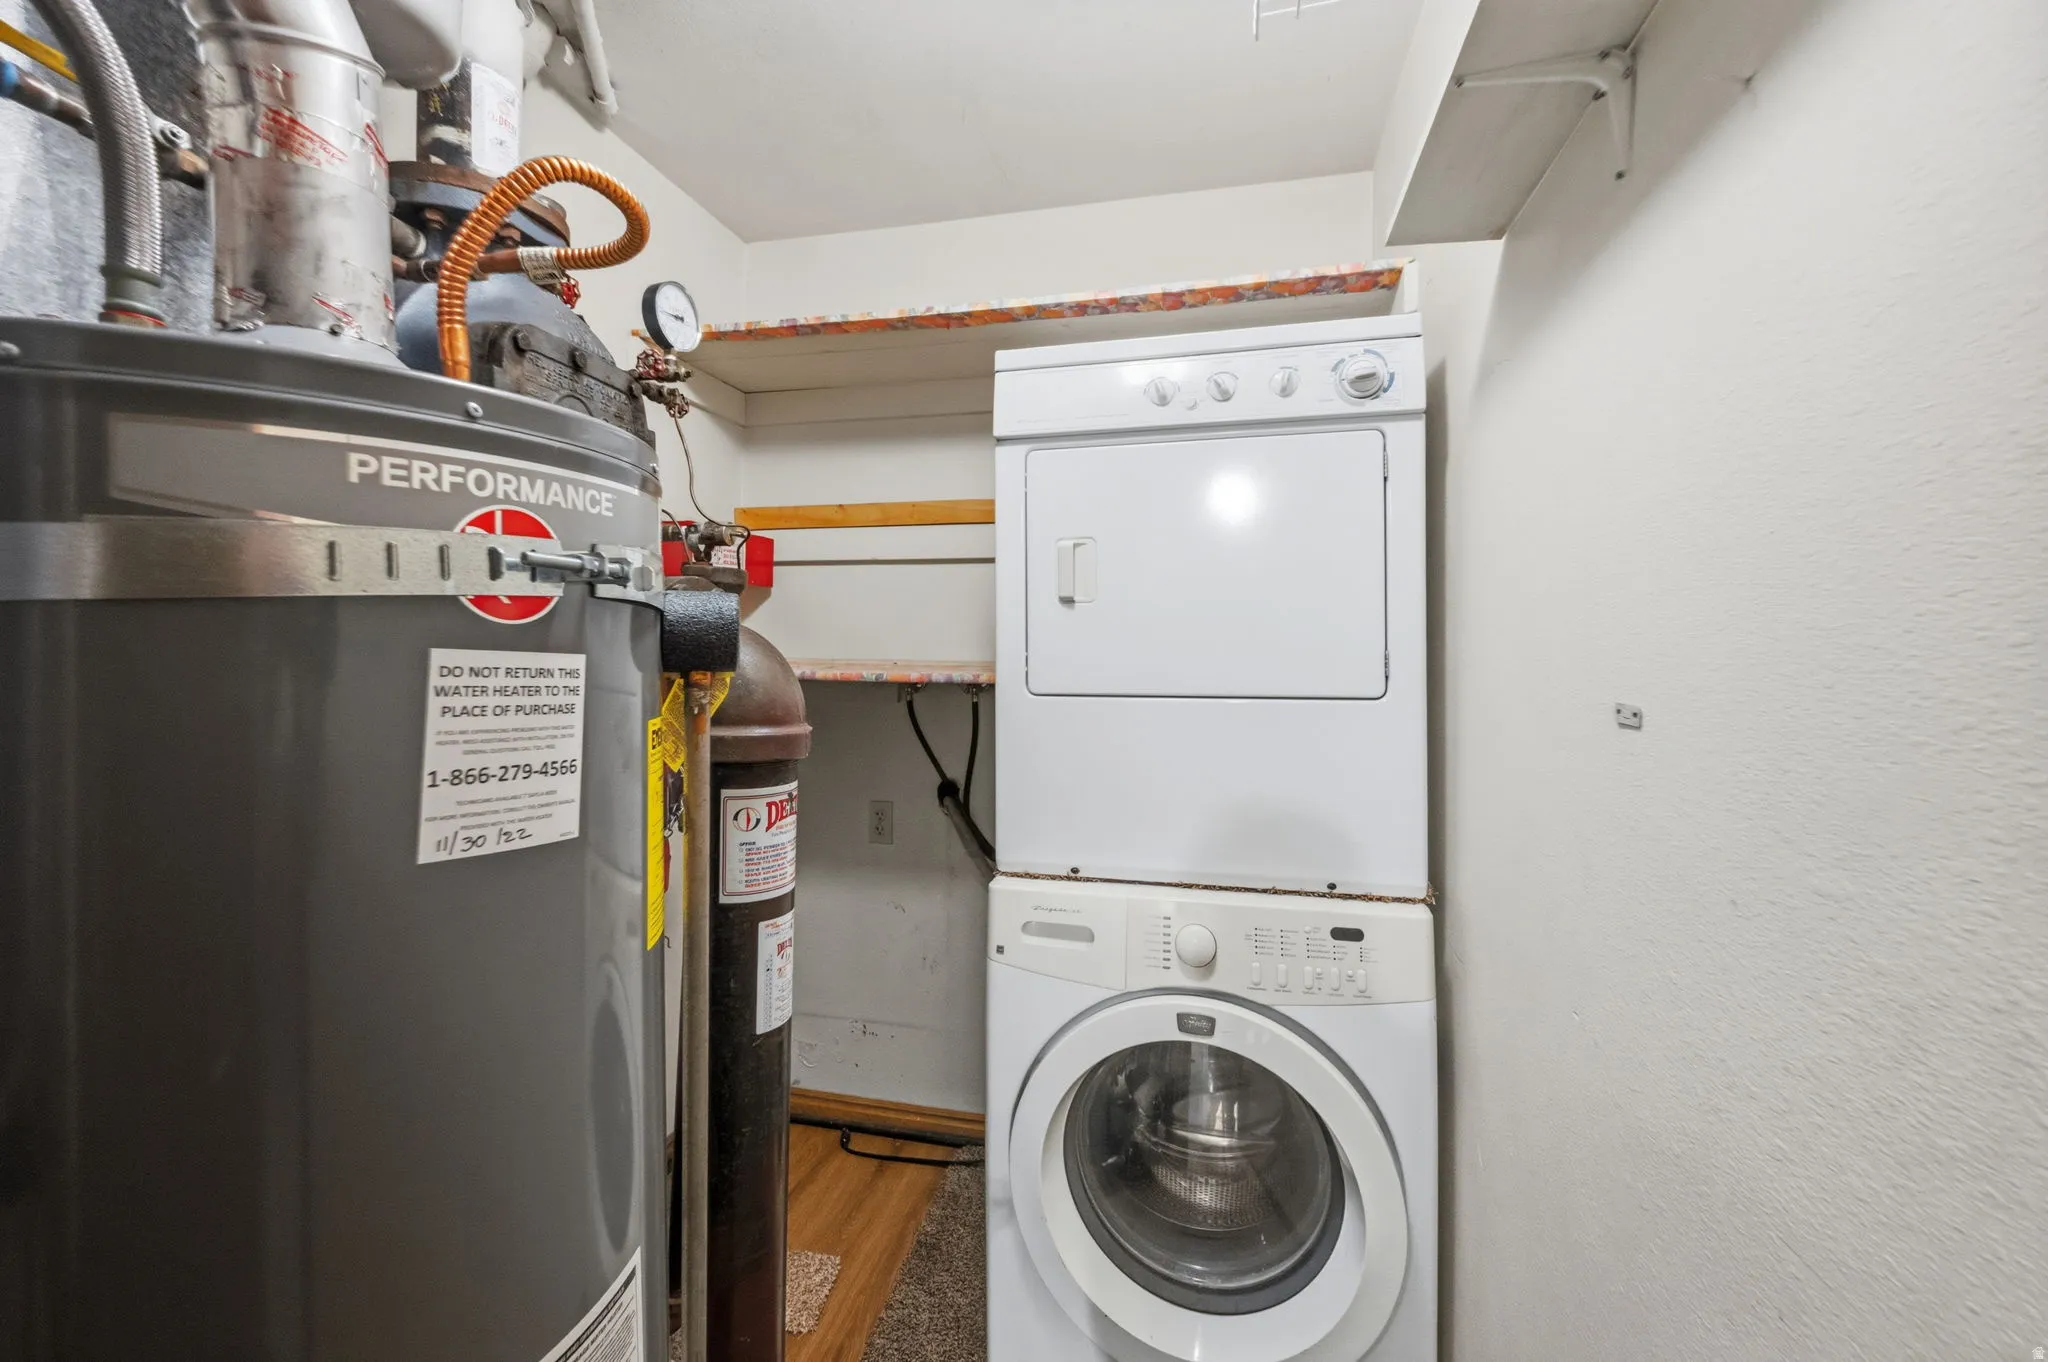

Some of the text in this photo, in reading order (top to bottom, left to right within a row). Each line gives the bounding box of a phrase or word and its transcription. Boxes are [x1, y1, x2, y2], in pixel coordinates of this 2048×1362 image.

[346, 452, 615, 517] PERFORMANCE
[439, 665, 581, 679] DO NOT RETURN THIS
[433, 685, 580, 697] WATER HEATER TO THE
[440, 703, 576, 717] PLACE OF PURCHASE
[426, 758, 578, 788] 1-866-279-4566
